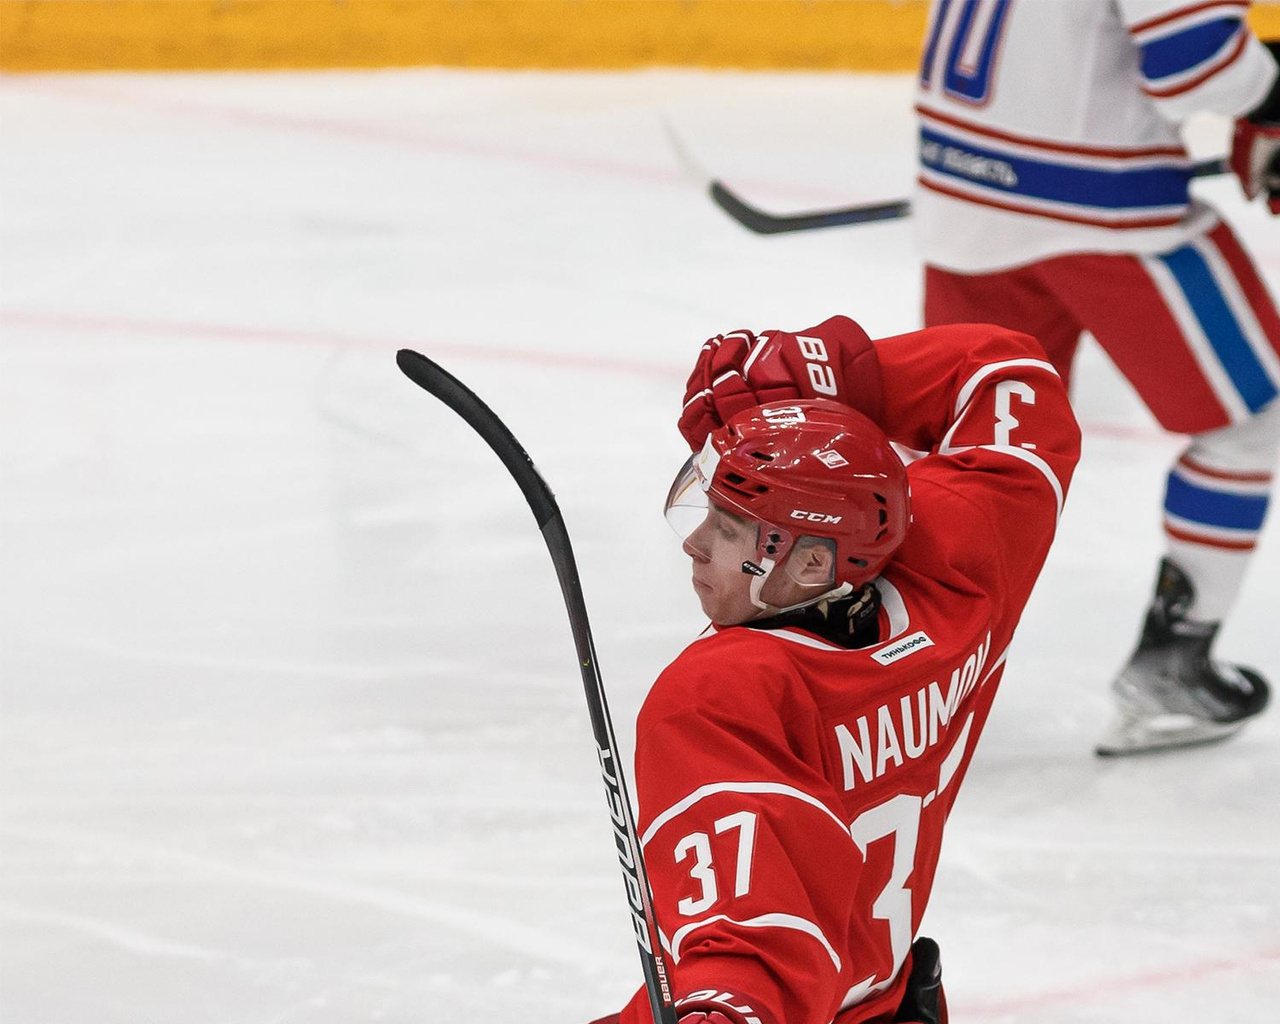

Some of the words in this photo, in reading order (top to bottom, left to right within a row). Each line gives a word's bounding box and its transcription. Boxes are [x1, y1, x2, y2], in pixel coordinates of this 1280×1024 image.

[790, 509, 843, 525] CCM
[742, 561, 767, 577] CCM
[673, 811, 757, 917] 37
